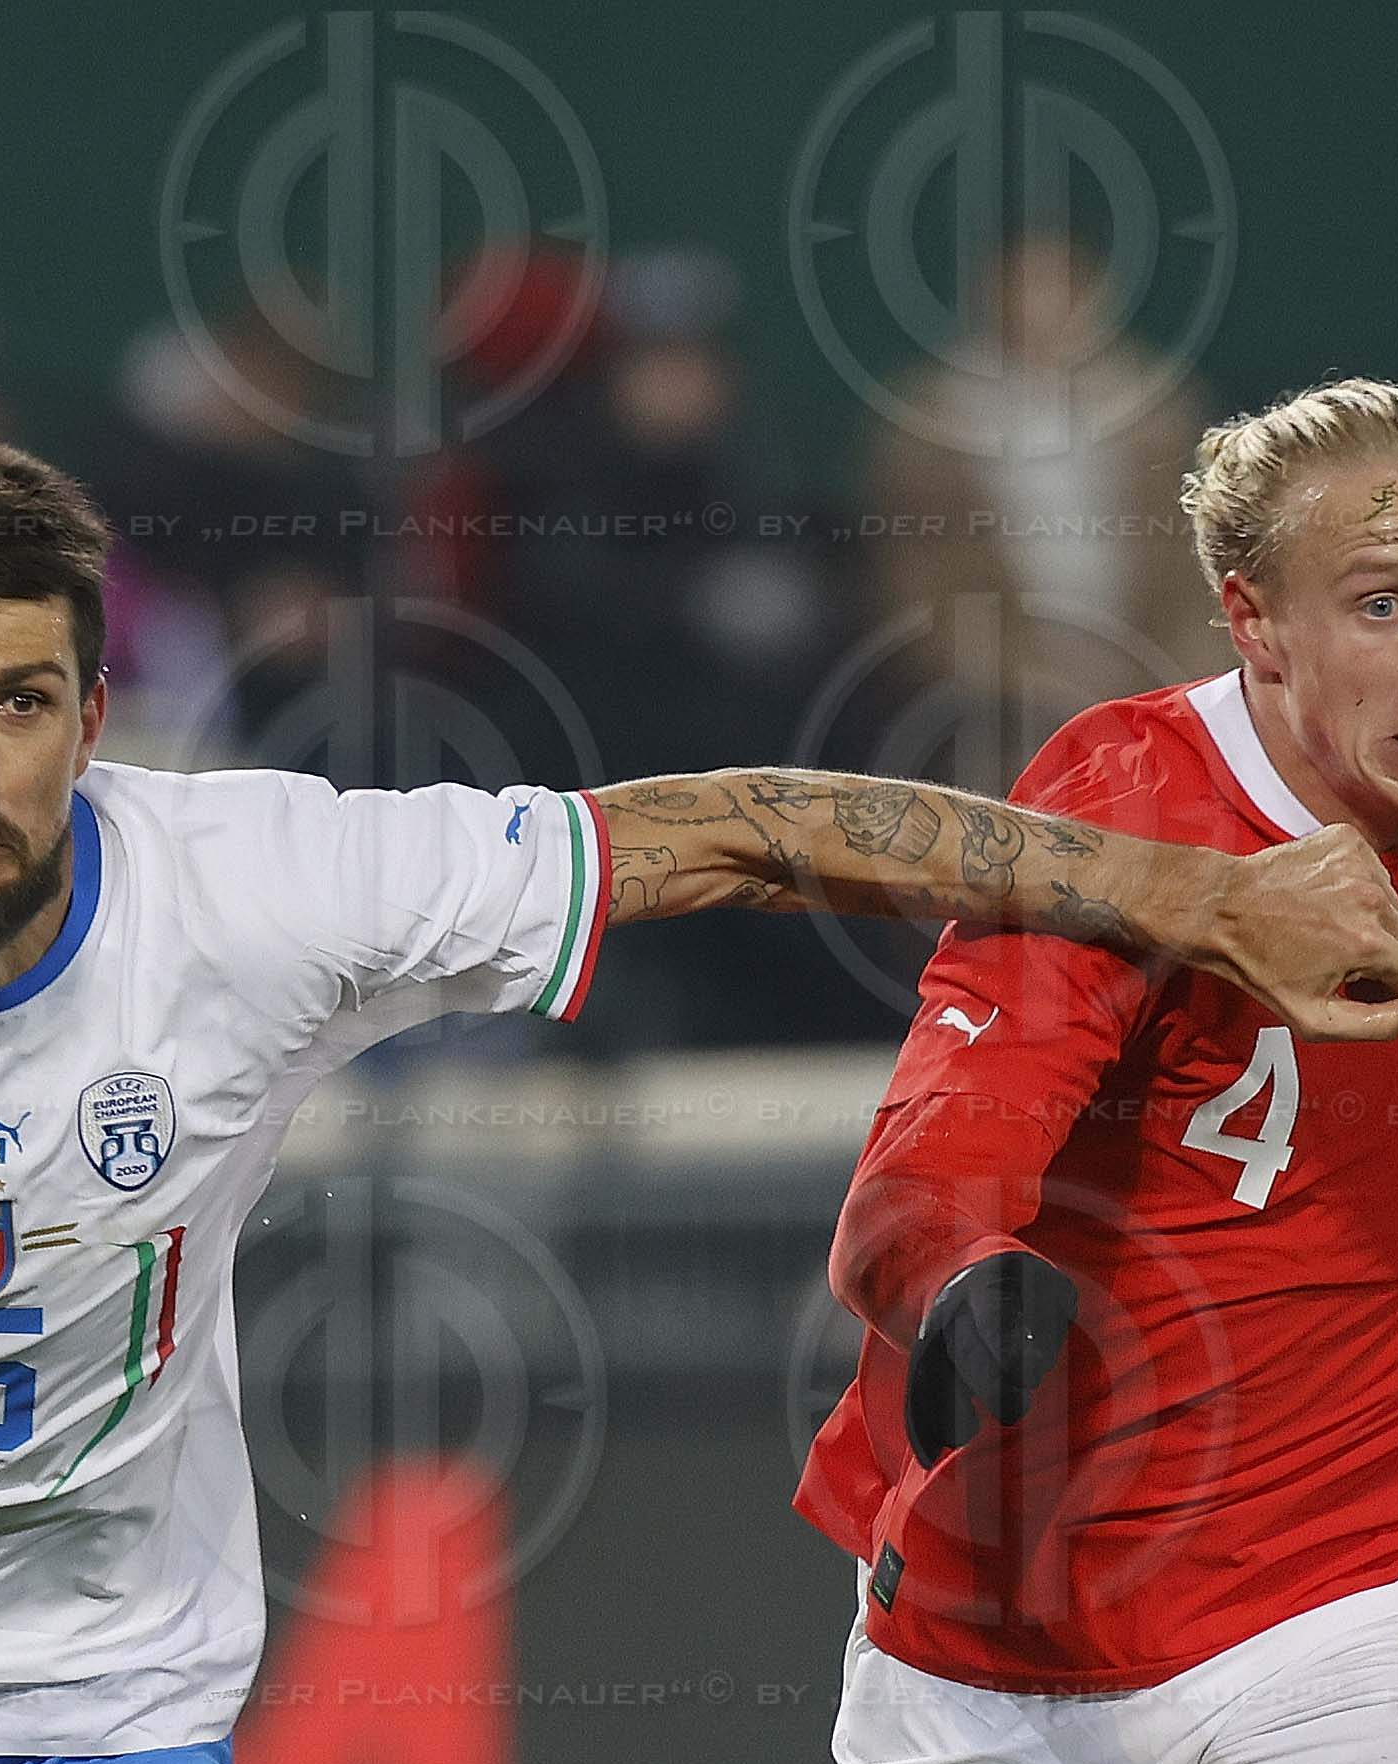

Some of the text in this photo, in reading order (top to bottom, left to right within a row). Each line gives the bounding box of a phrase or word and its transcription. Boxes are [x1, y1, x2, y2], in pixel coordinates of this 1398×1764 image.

[104, 1081, 141, 1095] UEFA
[94, 1093, 157, 1110] EUROPEAN
[94, 1103, 157, 1119] CHAMPIONS
[1181, 1026, 1299, 1210] 4
[116, 1164, 147, 1176] 2020
